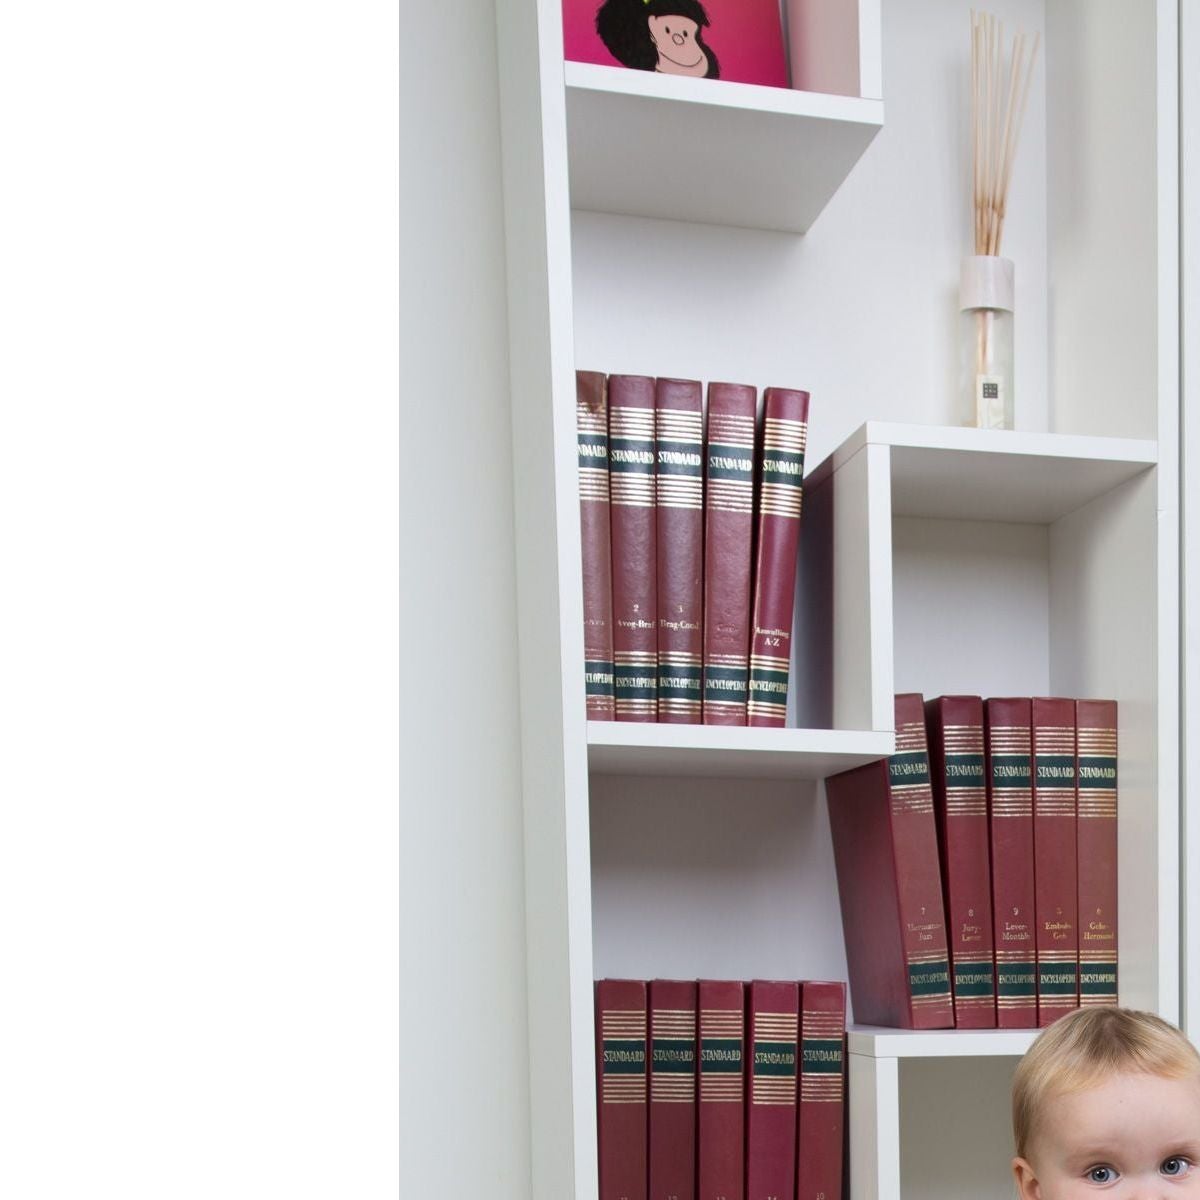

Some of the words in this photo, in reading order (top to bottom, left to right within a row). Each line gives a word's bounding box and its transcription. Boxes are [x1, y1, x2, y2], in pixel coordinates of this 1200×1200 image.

[611, 450, 654, 465] STANDAARD
[658, 450, 701, 466] STANDAARD
[709, 455, 753, 472] STANDAARD
[763, 459, 804, 475] STANDAARD
[633, 604, 639, 612] 2
[764, 637, 781, 647] A-Z
[889, 764, 928, 776] STANDAARD
[946, 764, 983, 776] STANDAARD
[993, 765, 1031, 777] STANDAARD
[1037, 766, 1075, 778] STANDAARD
[1079, 767, 1116, 778] STANDAARD
[1013, 907, 1019, 916] 9
[604, 1050, 645, 1062] STANDAARD
[652, 1050, 694, 1062] STANDAARD
[701, 1049, 741, 1061] STANDAARD
[755, 1052, 794, 1064] STANDAARD
[803, 1050, 842, 1062] STANDAARD
